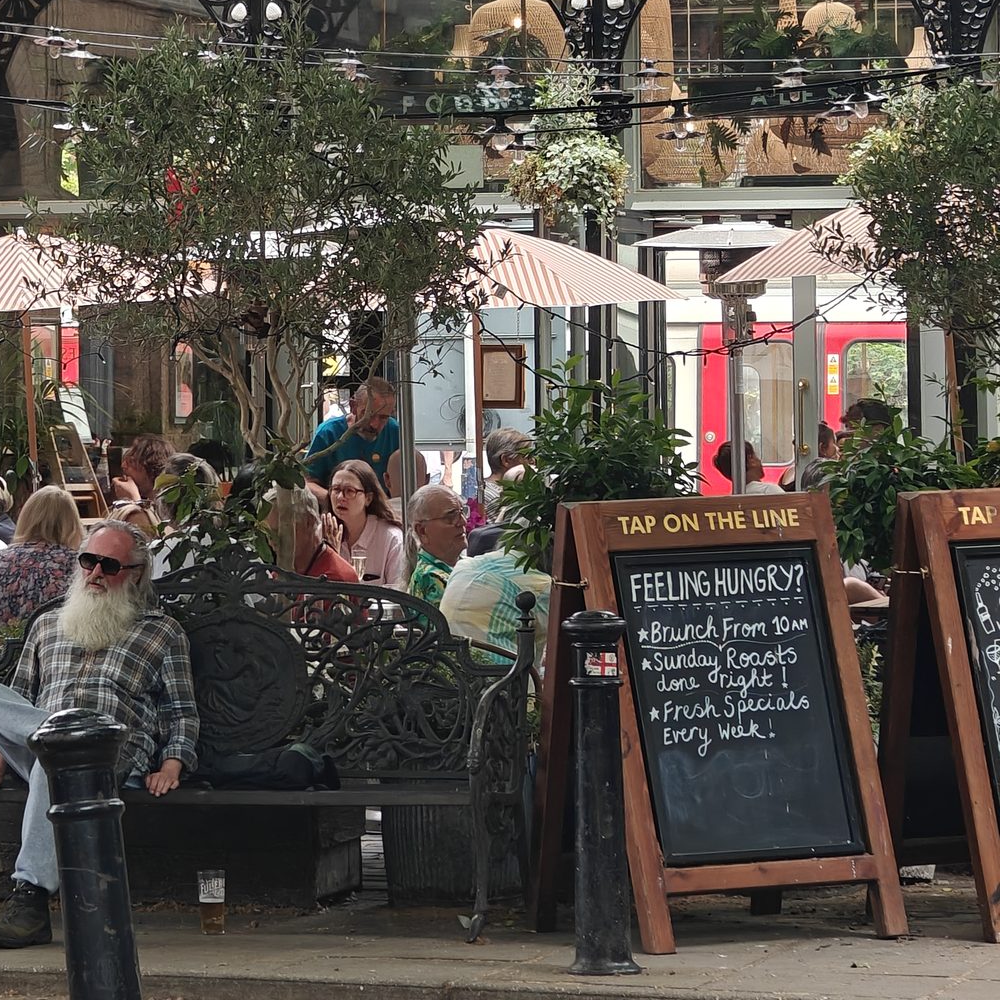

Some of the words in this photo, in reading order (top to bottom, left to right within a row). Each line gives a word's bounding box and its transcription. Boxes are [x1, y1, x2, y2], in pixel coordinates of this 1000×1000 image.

[617, 514, 657, 535] TAP
[663, 512, 700, 533] ON
[704, 510, 747, 532] THE
[752, 508, 800, 529] LINE
[957, 505, 998, 526] TAP
[630, 570, 710, 602] FEELING
[714, 564, 804, 597] HUNGRY?
[651, 615, 719, 644] Brunch
[722, 617, 768, 642] From
[653, 647, 721, 684] Sunday
[726, 644, 798, 670] Roasts
[657, 673, 700, 692] done
[663, 696, 721, 722] Fresh
[724, 691, 810, 725] Specials
[663, 727, 712, 757] Every
